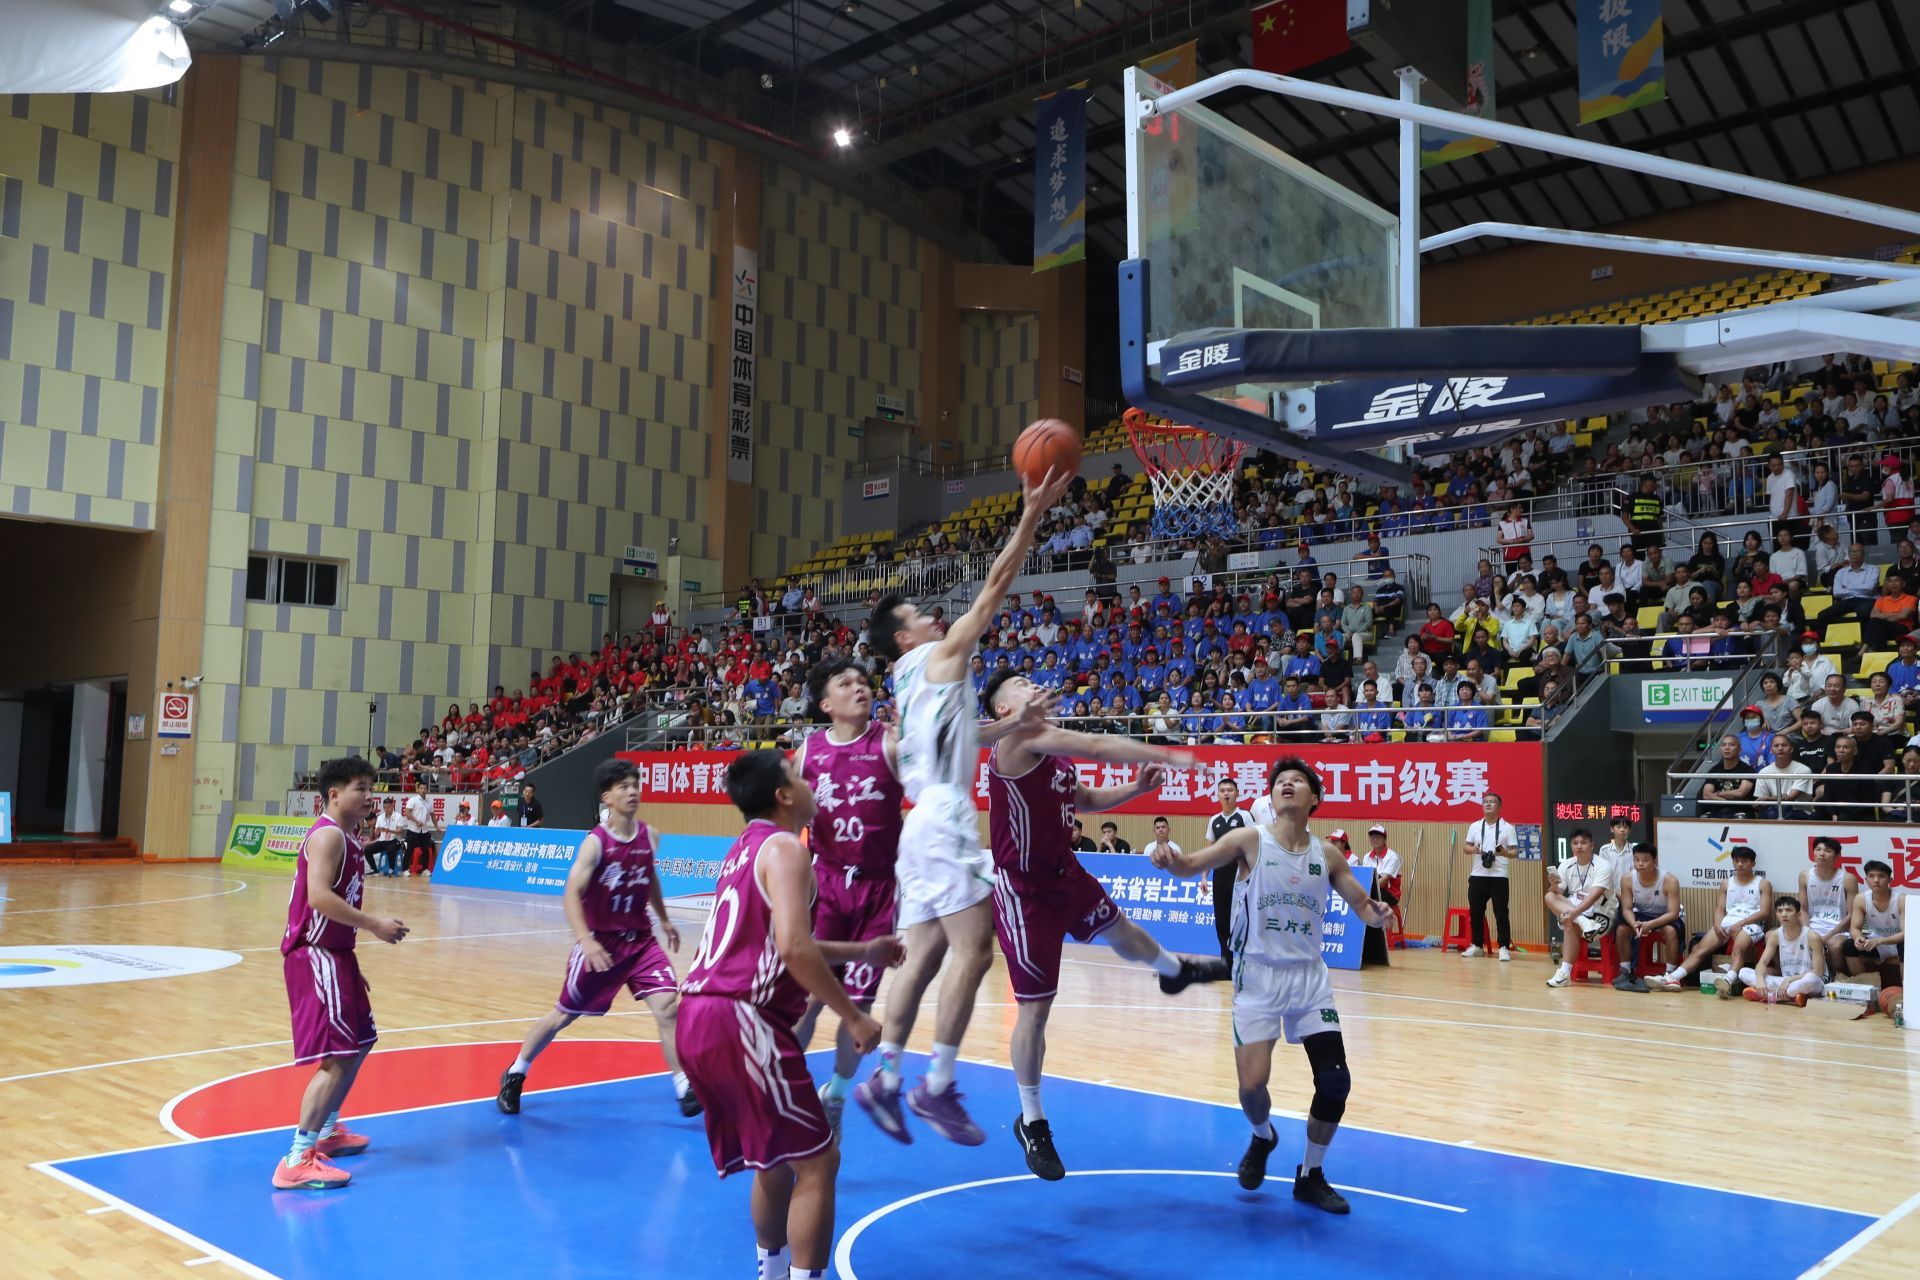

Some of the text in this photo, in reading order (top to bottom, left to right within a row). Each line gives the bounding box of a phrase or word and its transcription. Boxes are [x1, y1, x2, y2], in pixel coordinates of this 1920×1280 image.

[1050, 117, 1069, 222] 追求梦想
[1172, 343, 1236, 373] 金陵
[731, 304, 754, 461] 中国体育彩票
[1348, 377, 1526, 425] 金陵
[1673, 687, 1698, 702] EXIT
[1556, 803, 1584, 819] 坡头区
[833, 816, 864, 842] 20
[611, 894, 634, 914] 11
[843, 960, 874, 989] 20
